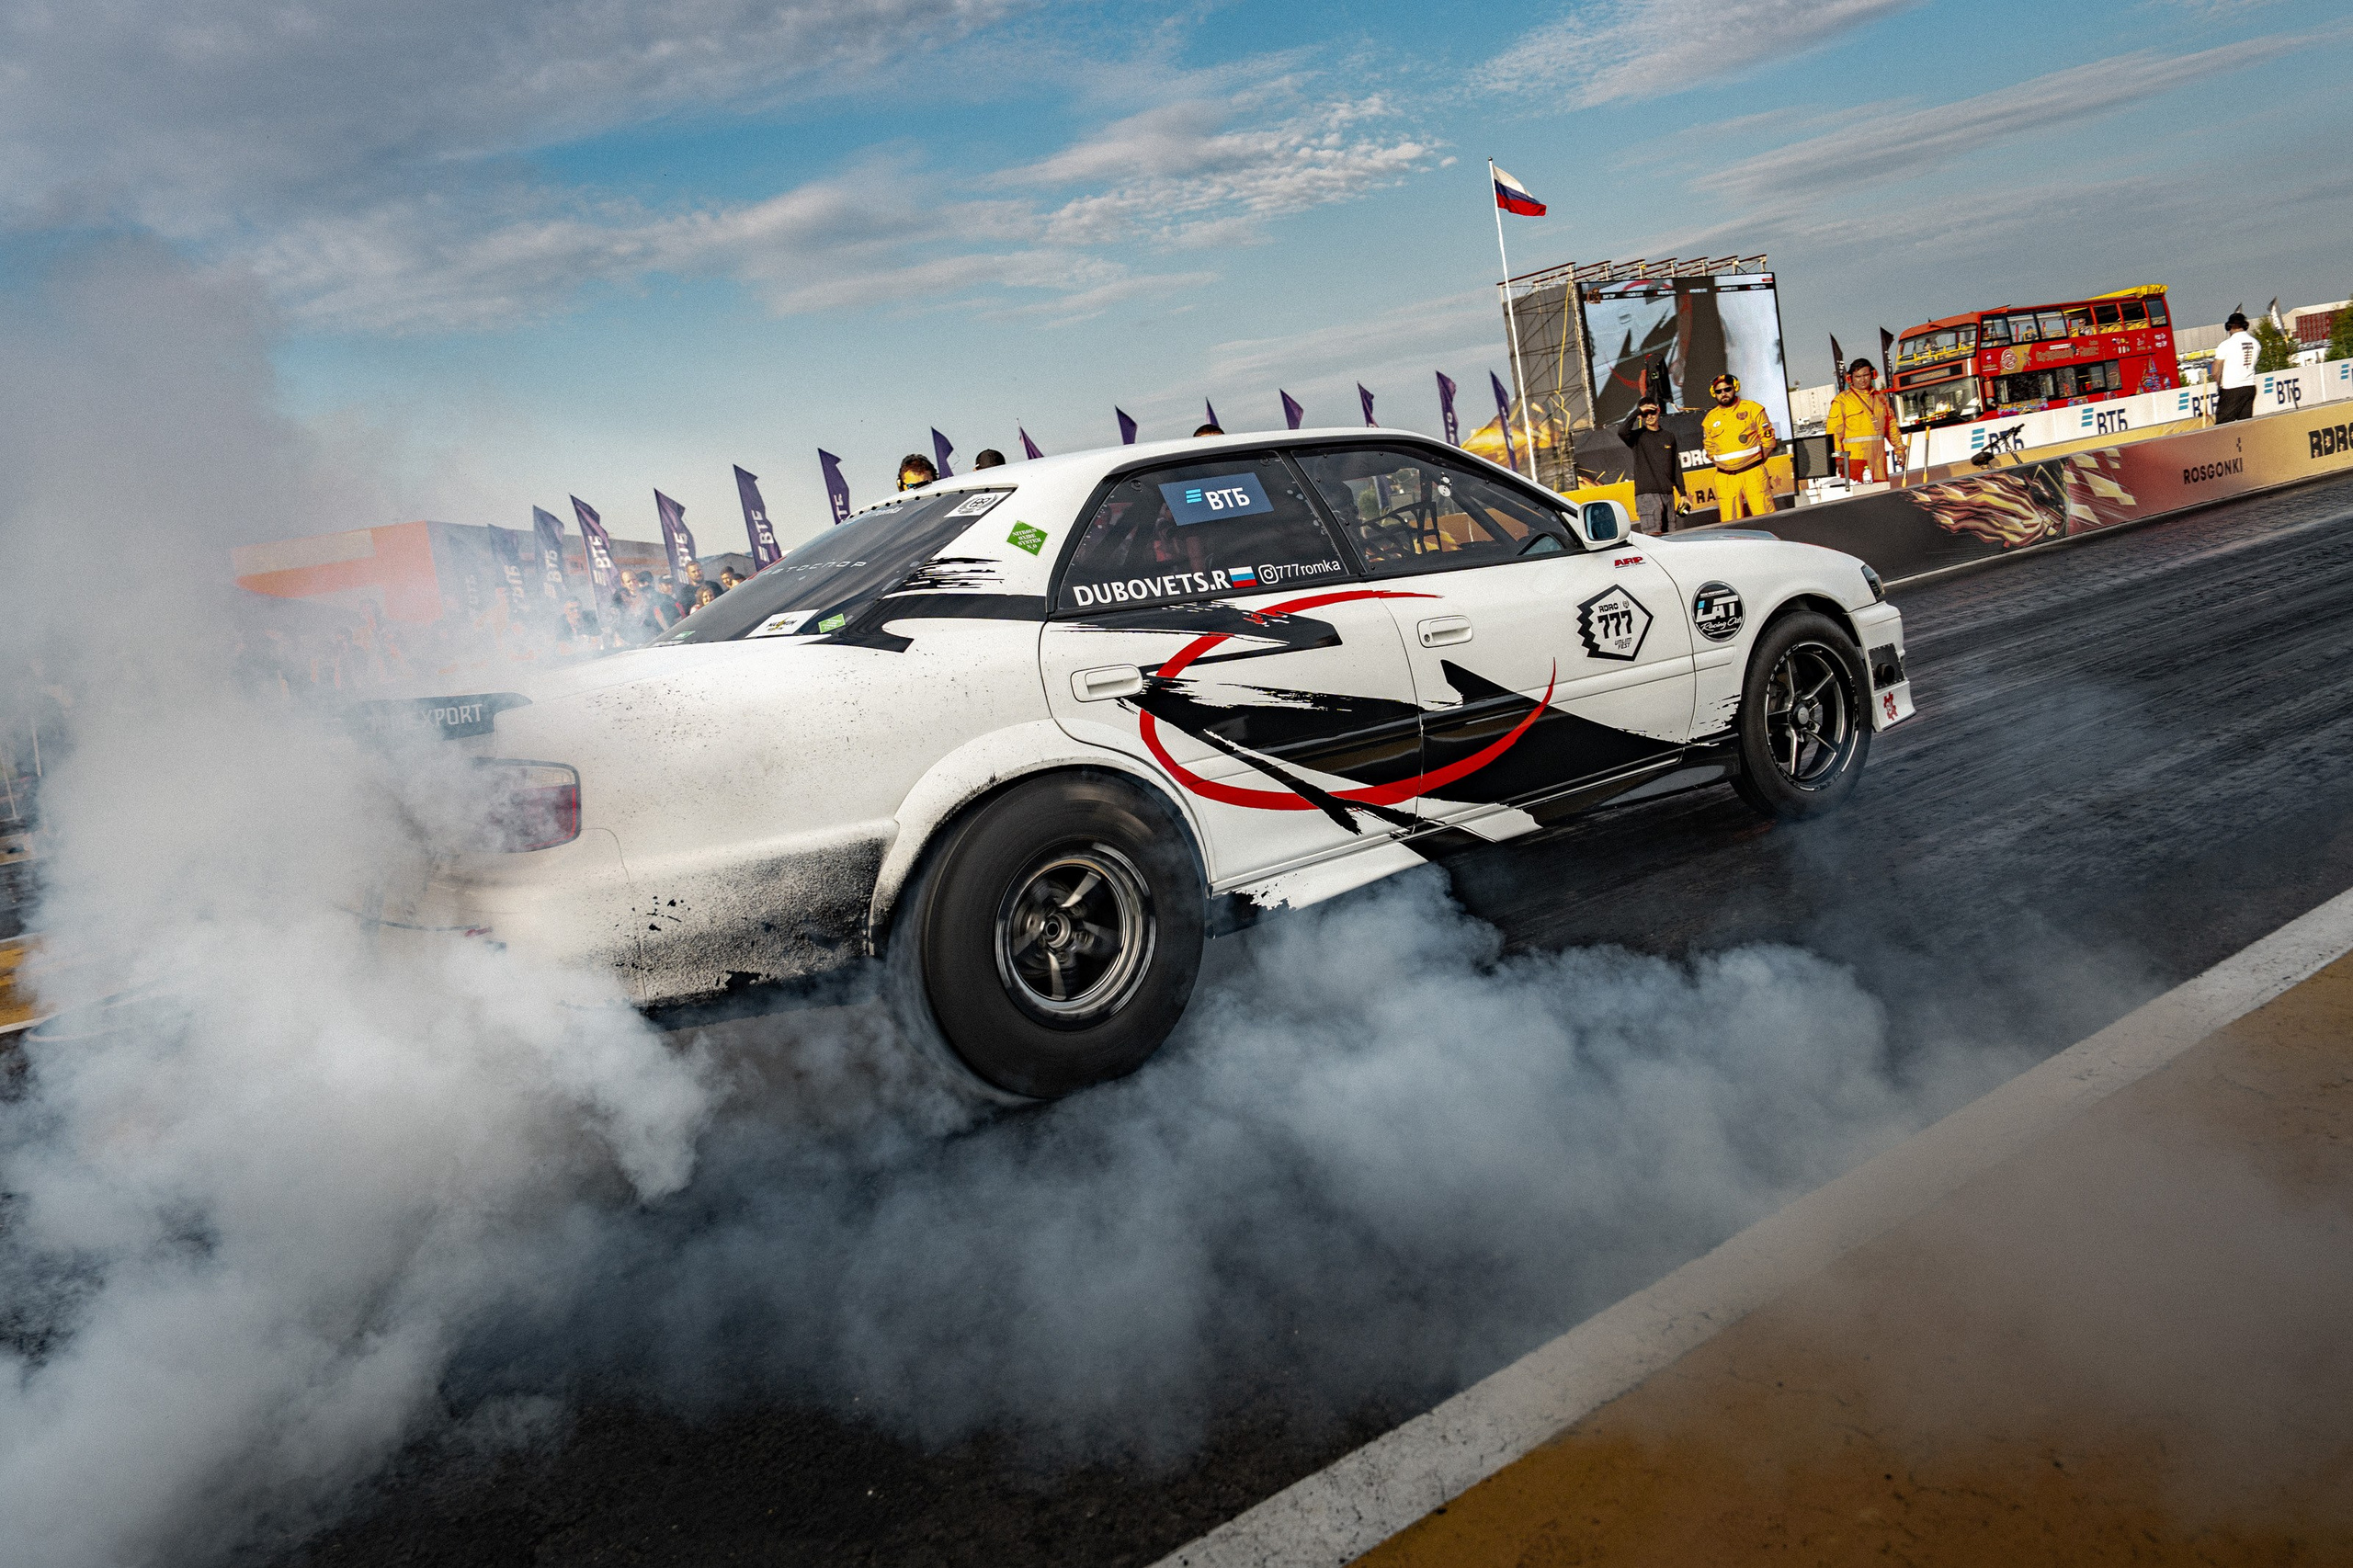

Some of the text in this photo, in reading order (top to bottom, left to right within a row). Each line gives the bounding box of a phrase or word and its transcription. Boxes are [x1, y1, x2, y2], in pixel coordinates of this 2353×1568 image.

[2276, 378, 2302, 404] ВТБ
[2097, 408, 2128, 434] ВТБ
[1678, 449, 1713, 468] DRC
[2183, 457, 2244, 484] ROSGONKI
[1205, 487, 1250, 510] ВТБ
[587, 535, 611, 568] ВТБ
[1614, 556, 1643, 566] ARP
[1073, 561, 1341, 607] DUBOVETS.R 777romka
[1598, 602, 1619, 613] RDRC
[1696, 595, 1738, 622] LAT
[1597, 609, 1632, 639] 777
[1700, 621, 1726, 631] Racing
